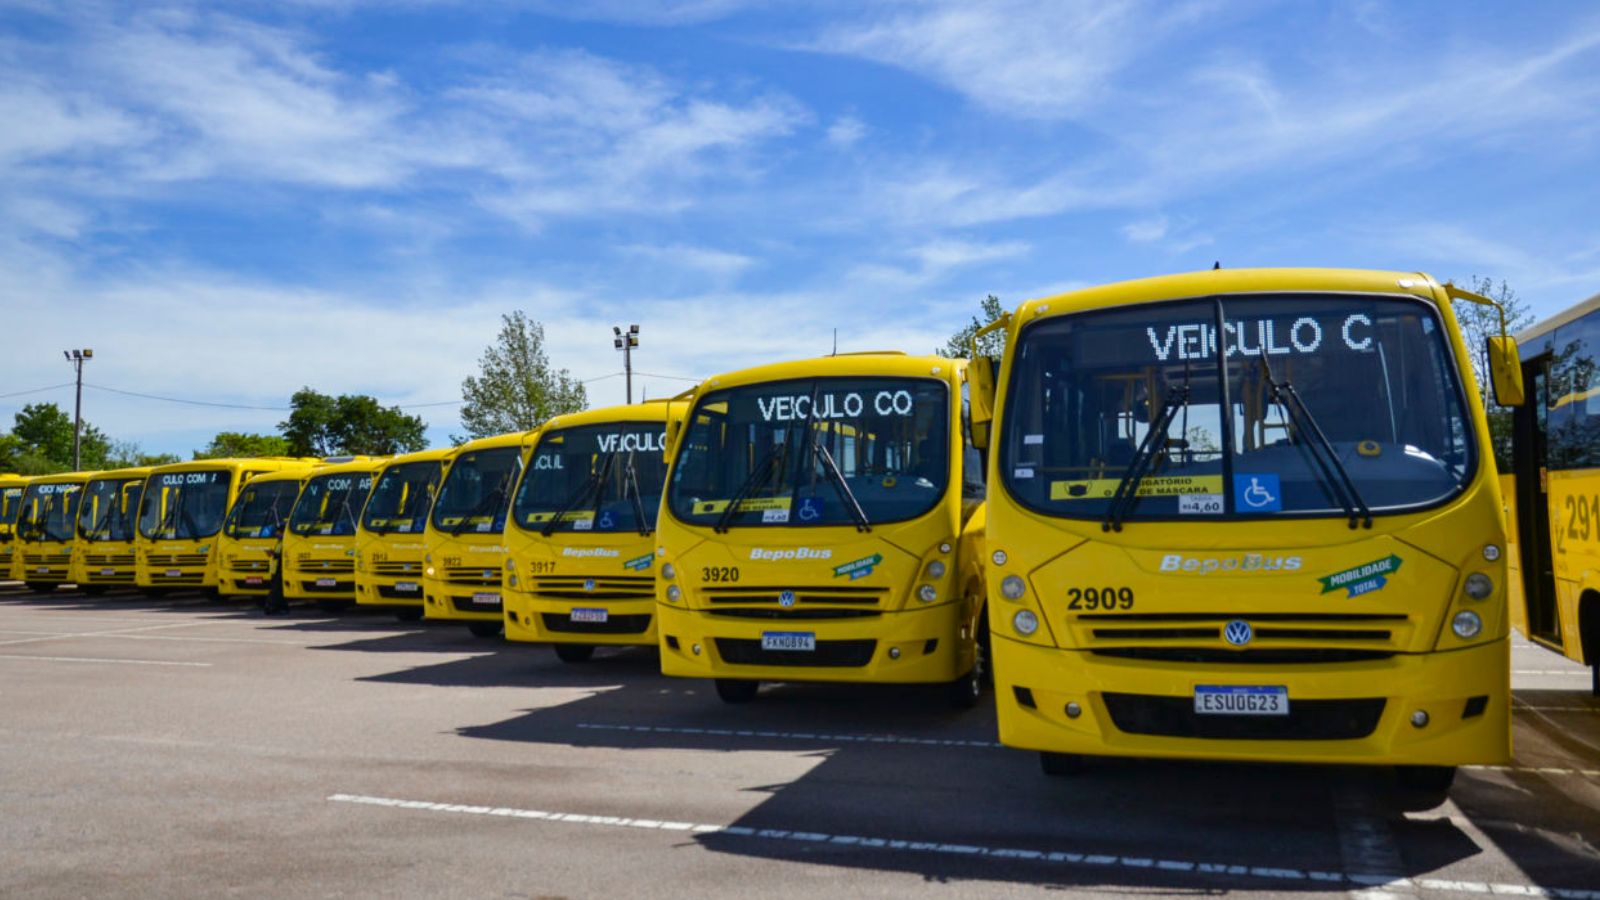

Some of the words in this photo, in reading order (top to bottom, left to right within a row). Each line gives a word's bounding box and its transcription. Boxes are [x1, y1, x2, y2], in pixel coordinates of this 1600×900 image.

[1147, 317, 1322, 360] VEICULO
[1342, 314, 1372, 350] C
[757, 393, 864, 421] VEICULO
[875, 390, 913, 416] CO
[750, 547, 833, 561] BepoBus
[1159, 553, 1303, 576] BepoBus
[530, 561, 556, 573] 3917
[701, 567, 740, 583] 3920
[1330, 558, 1393, 587] MOBILIDADE
[1354, 578, 1379, 595] TOTAL
[1067, 587, 1135, 611] 2909
